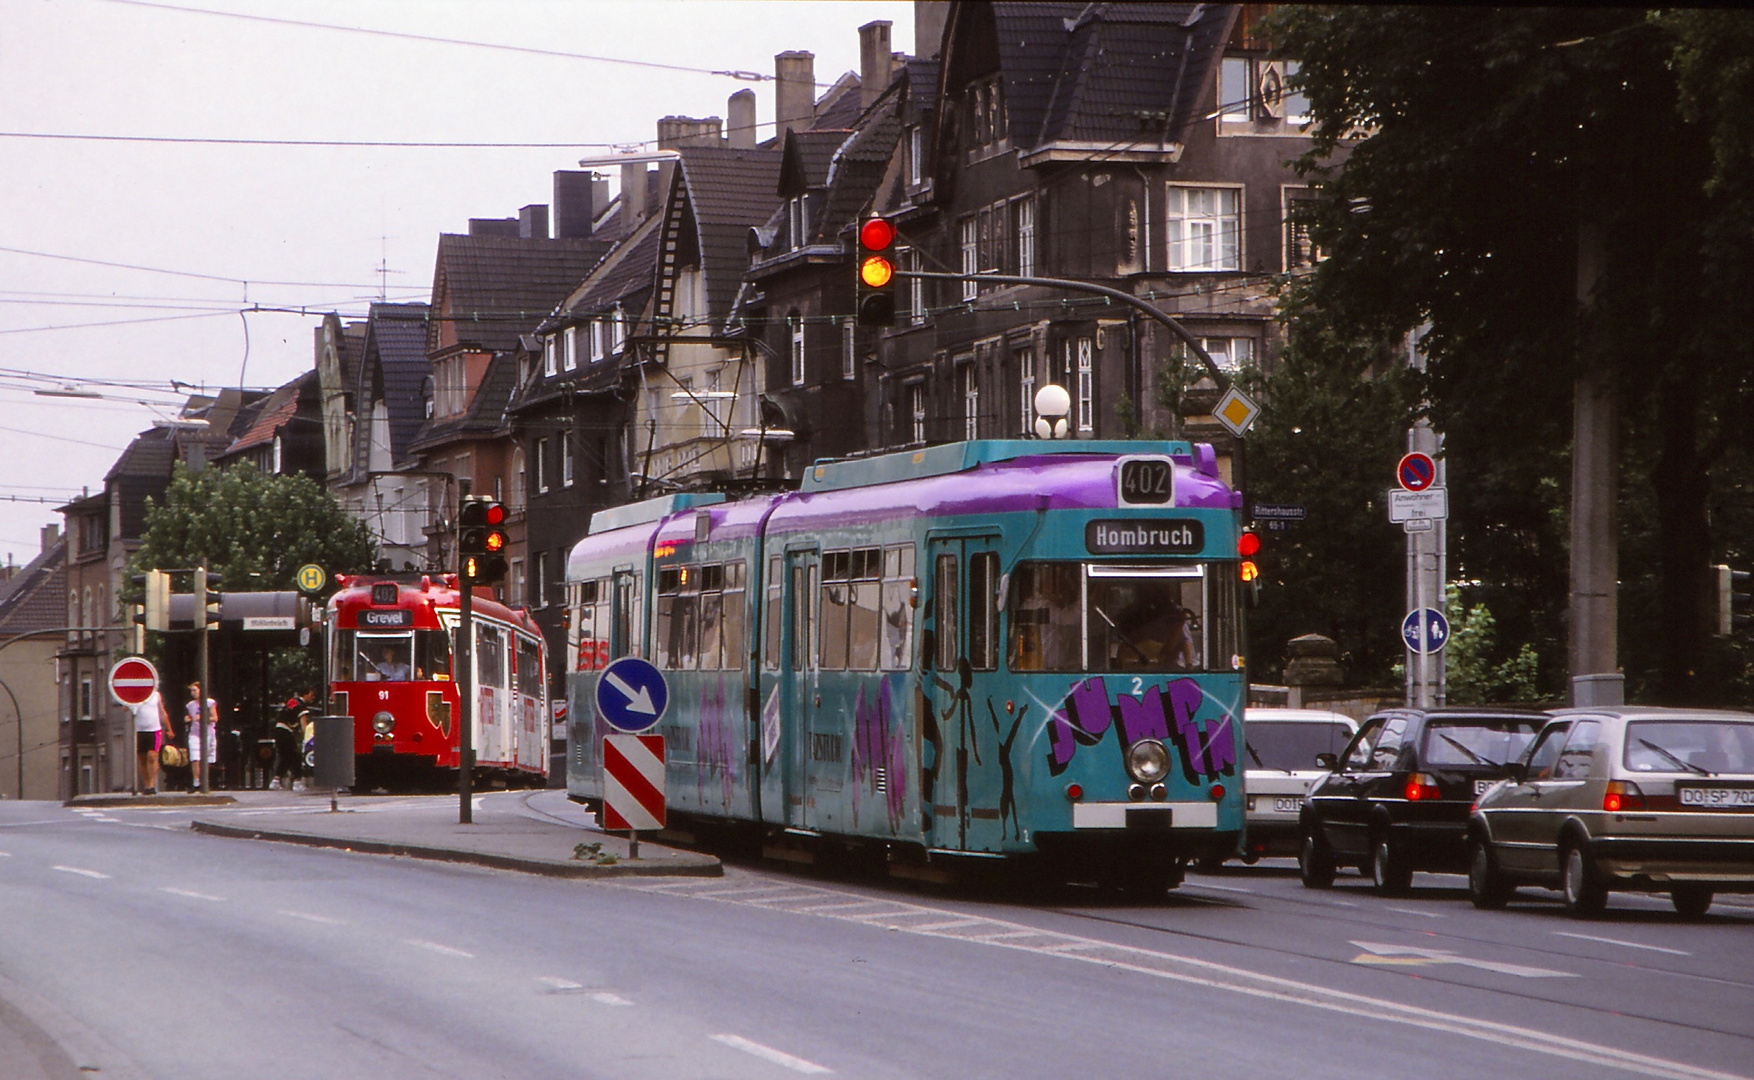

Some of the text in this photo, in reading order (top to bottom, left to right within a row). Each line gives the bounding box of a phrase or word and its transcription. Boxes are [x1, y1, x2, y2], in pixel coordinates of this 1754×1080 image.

[1125, 464, 1167, 494] 402
[1096, 525, 1193, 546] Hombruch
[305, 571, 318, 585] H
[373, 587, 396, 602] 402
[366, 611, 403, 624] Grevel
[1131, 677, 1143, 695] 2
[378, 690, 389, 700] 91
[1048, 676, 1203, 775] JUMP
[1684, 790, 1704, 803] DO
[1711, 791, 1729, 803] SP
[1276, 799, 1292, 810] DO
